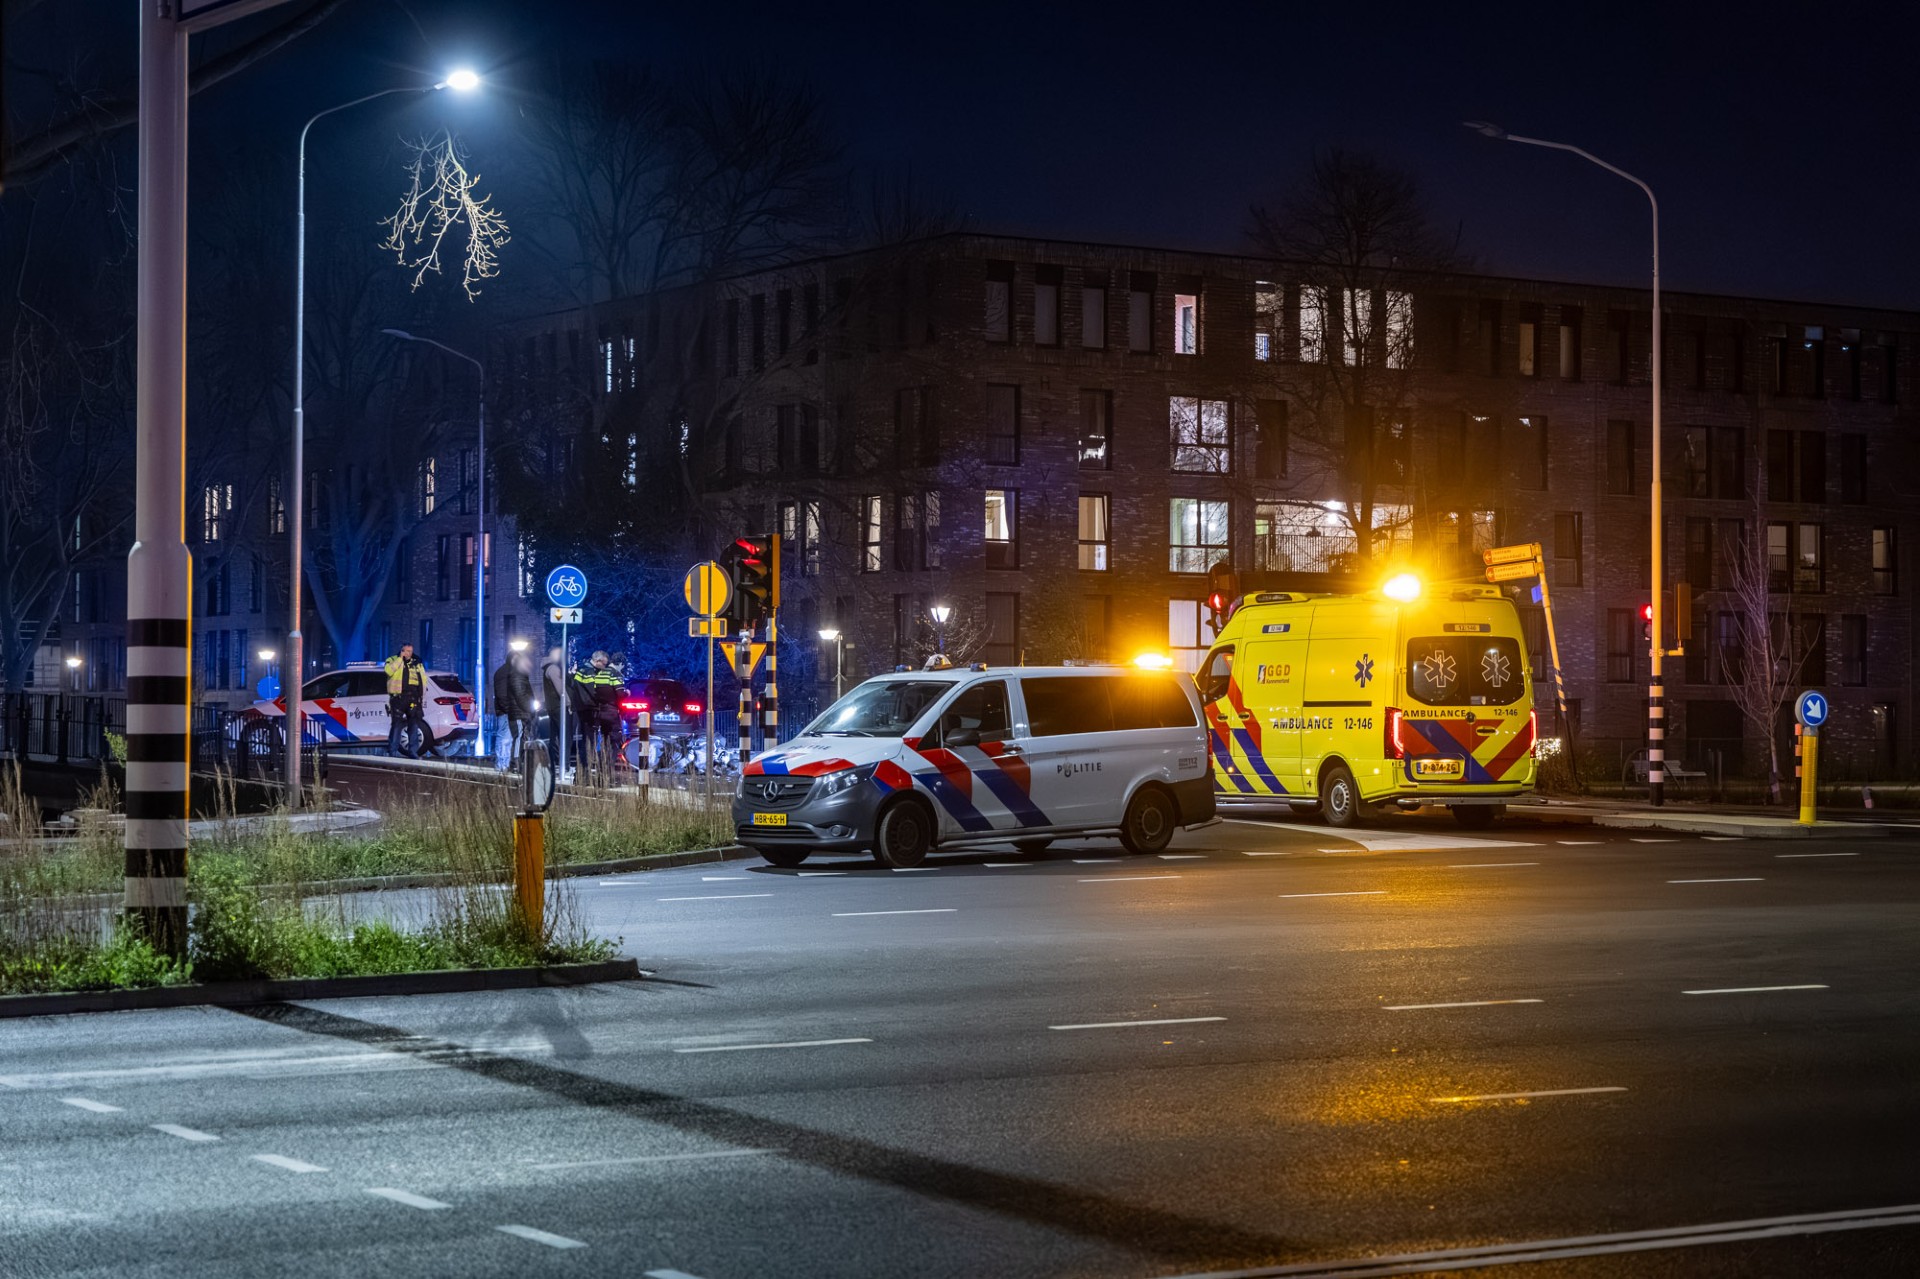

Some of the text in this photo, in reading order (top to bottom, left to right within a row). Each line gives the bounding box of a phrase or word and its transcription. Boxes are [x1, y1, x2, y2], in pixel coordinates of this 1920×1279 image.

[1268, 664, 1291, 676] GGD
[1403, 708, 1518, 718] AMBULANCE 12-146
[1272, 717, 1373, 730] AMBULANCE 12-146
[1056, 762, 1102, 777] POLITIE
[754, 814, 785, 824] HBR-65-H
